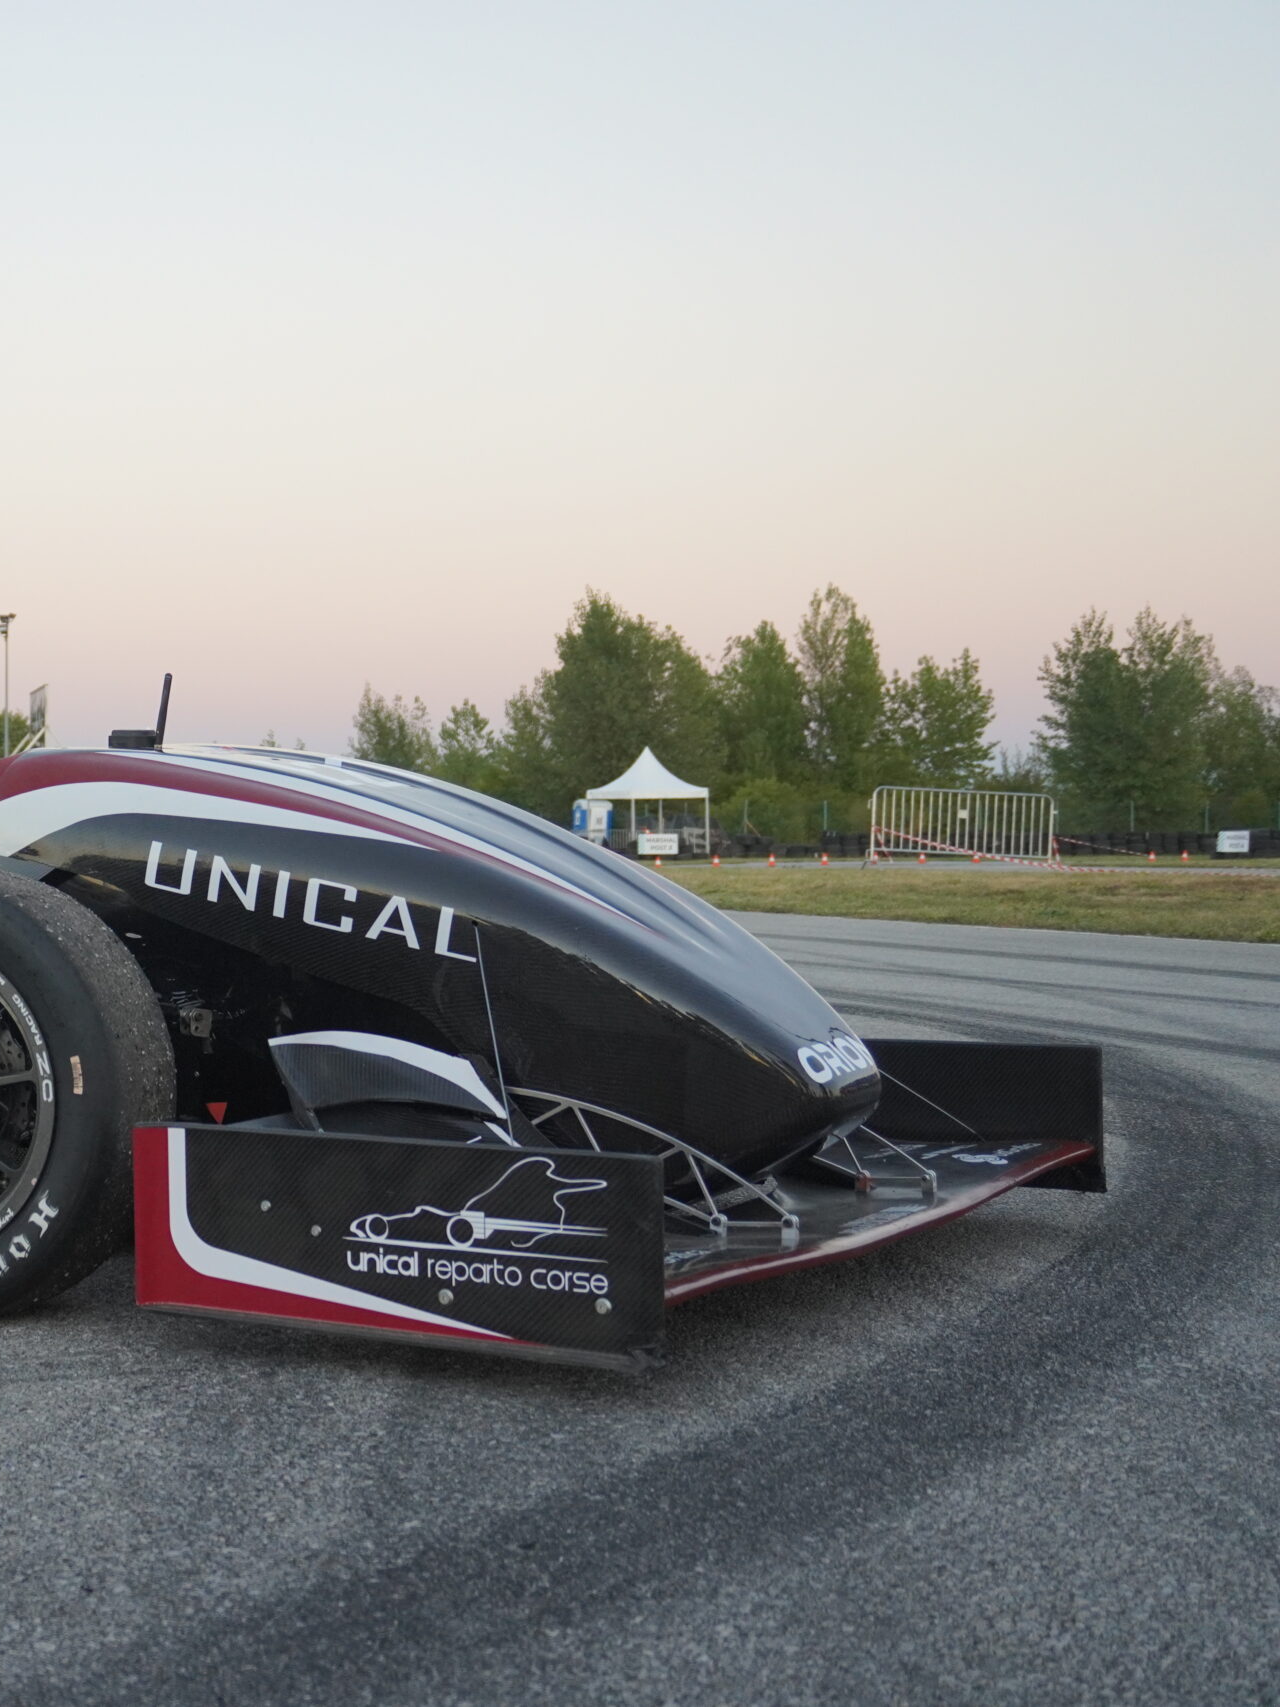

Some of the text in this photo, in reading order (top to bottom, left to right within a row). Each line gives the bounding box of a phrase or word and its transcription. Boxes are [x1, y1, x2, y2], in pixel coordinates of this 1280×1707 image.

[144, 840, 477, 963] UNICAL
[11, 994, 43, 1046] RACING
[346, 1247, 609, 1295] unical reparto corse
